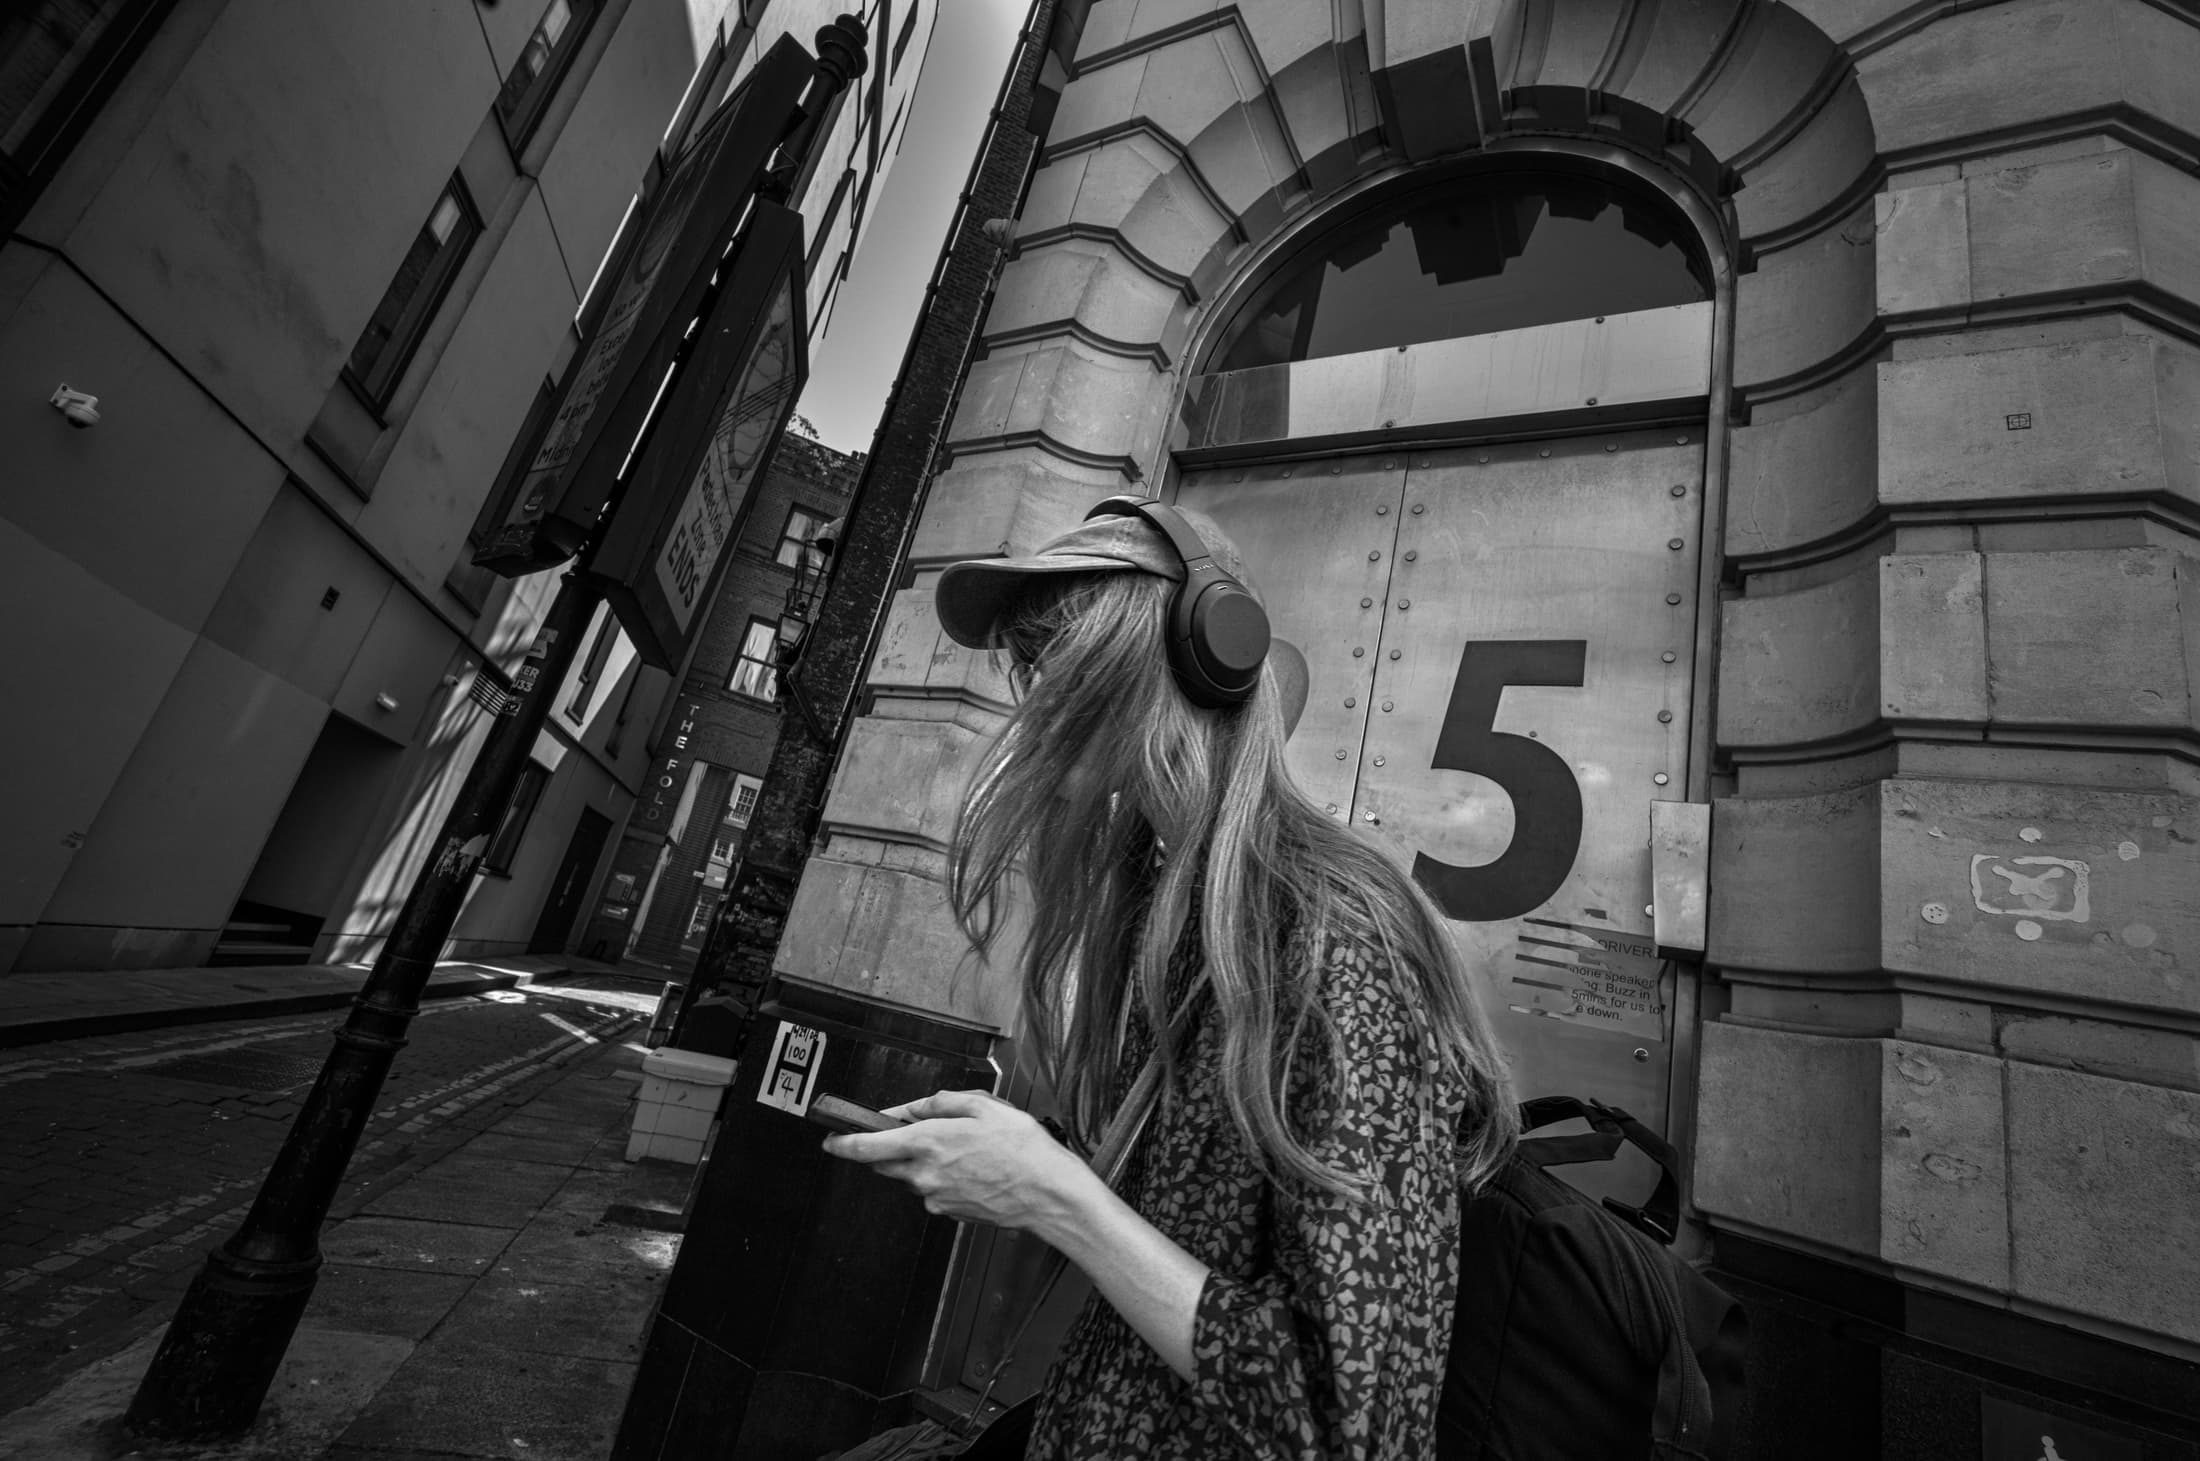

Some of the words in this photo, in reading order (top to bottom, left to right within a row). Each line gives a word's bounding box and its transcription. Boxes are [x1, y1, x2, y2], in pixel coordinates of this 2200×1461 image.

[668, 525, 701, 610] ENDS
[674, 704, 700, 750] THE
[1412, 640, 1586, 921] 5
[1598, 938, 1656, 959] RIVER
[1571, 989, 1607, 1005] 5mins
[1611, 996, 1627, 1009] for
[1630, 1002, 1645, 1012] us
[1649, 1004, 1661, 1015] to
[1606, 982, 1637, 998] Buzz
[1639, 989, 1651, 1001] in
[1587, 1005, 1623, 1021] down.
[788, 1045, 807, 1061] 100
[781, 1075, 794, 1099] 4
